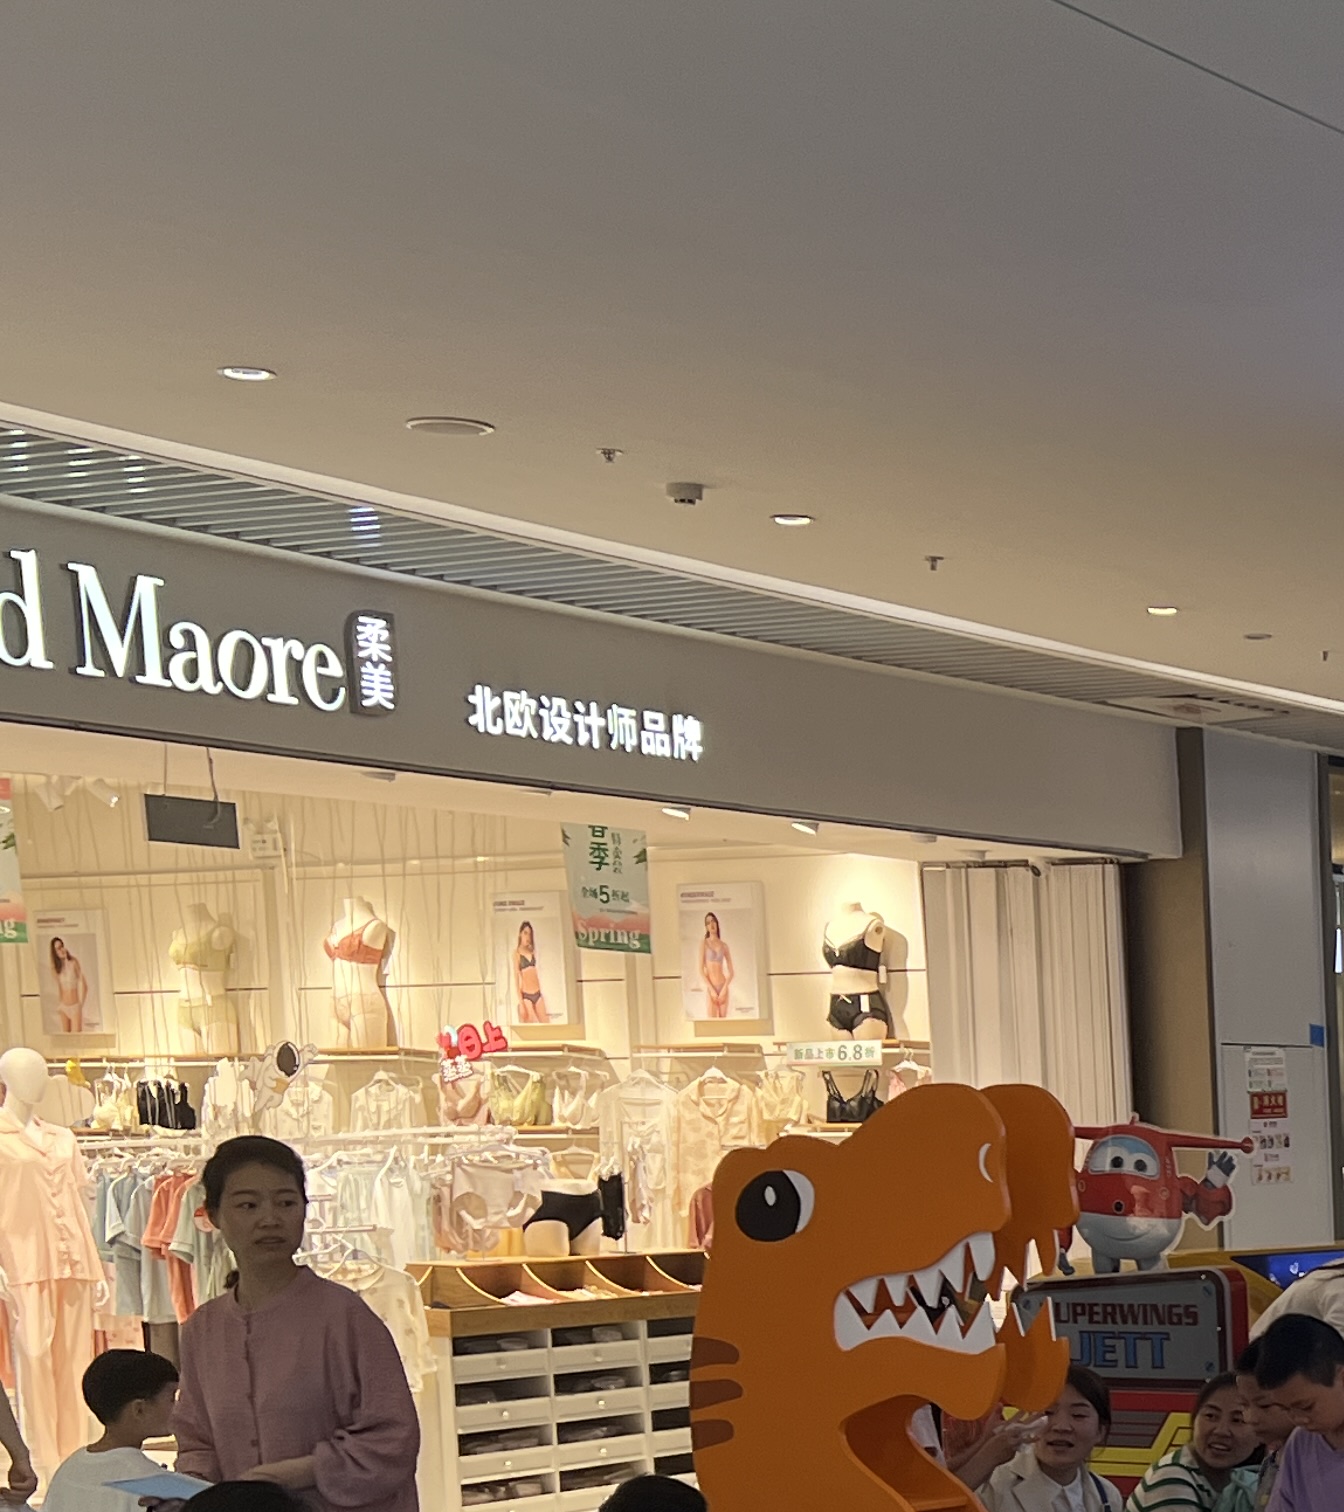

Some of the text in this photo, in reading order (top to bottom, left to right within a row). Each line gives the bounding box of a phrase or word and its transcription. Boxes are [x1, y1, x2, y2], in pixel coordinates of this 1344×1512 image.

[67, 561, 346, 712] Maore
[355, 615, 395, 710] 柔美
[468, 684, 704, 762] 北欧设计师品牌
[577, 919, 641, 949] Spring
[1050, 1301, 1199, 1327] UPERWINGS
[1070, 1330, 1171, 1369] JETT
